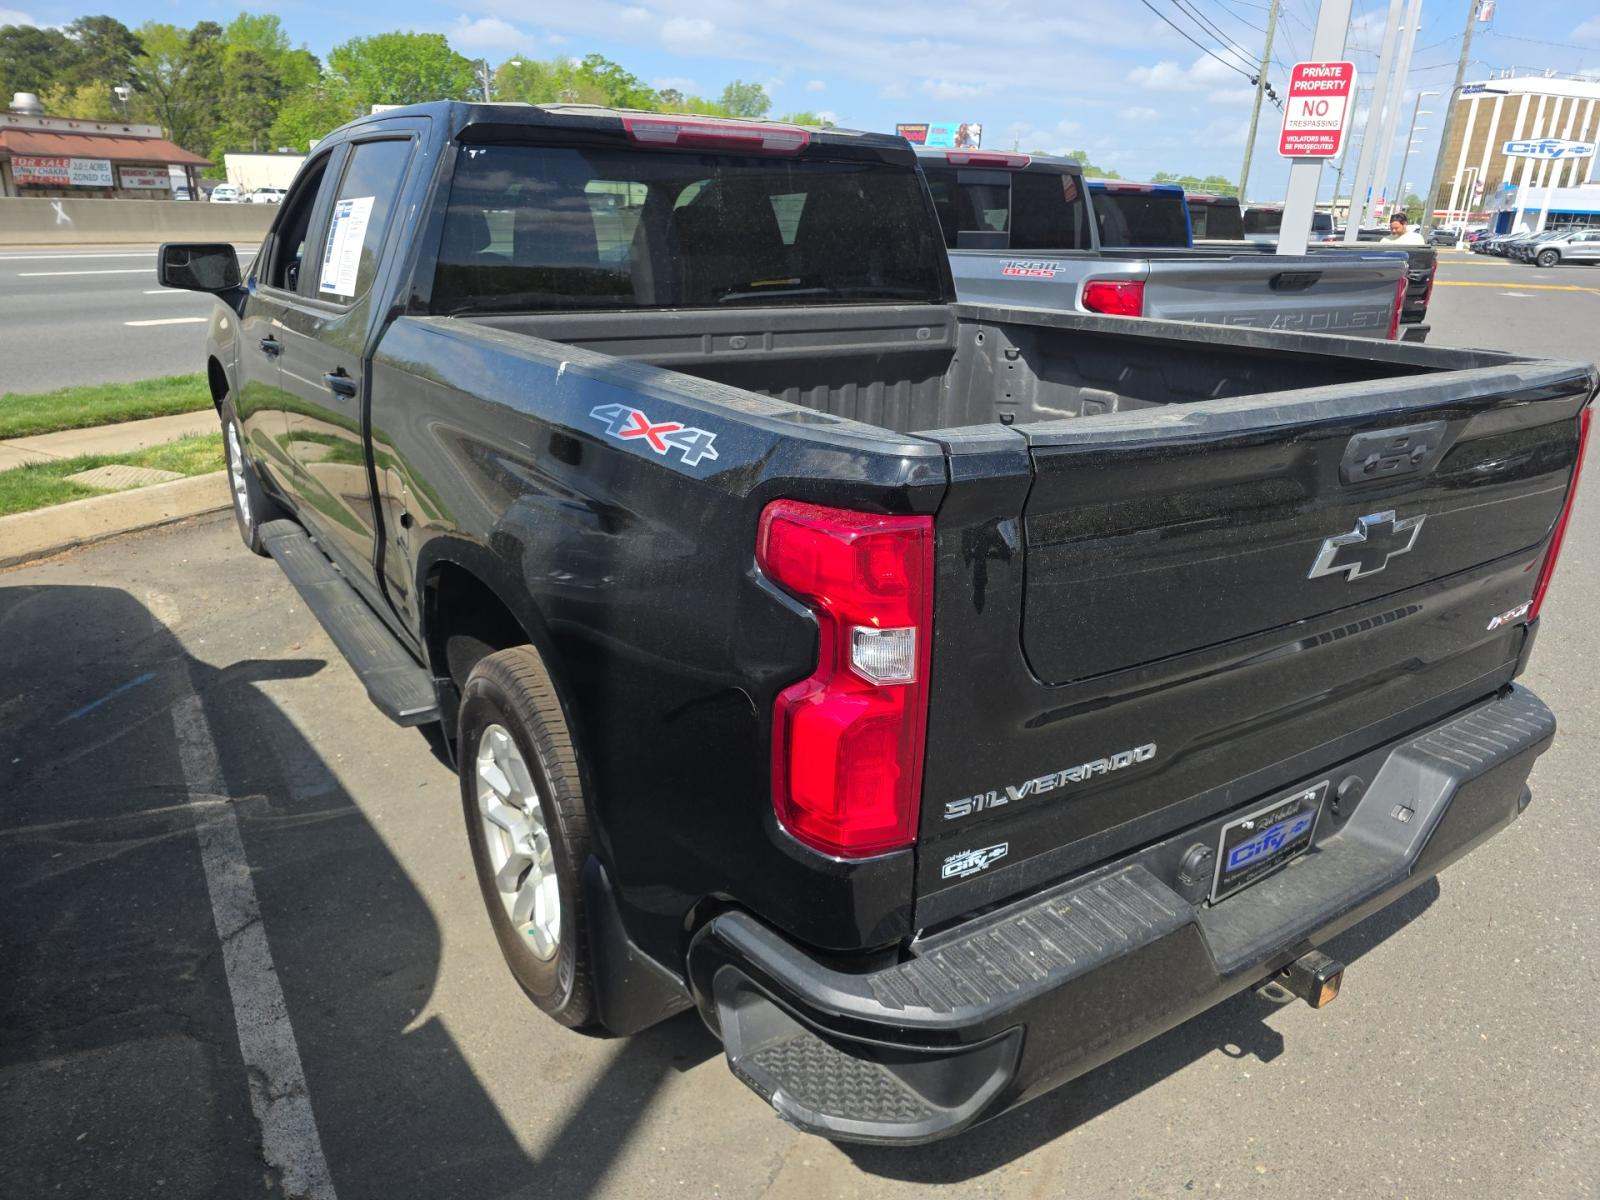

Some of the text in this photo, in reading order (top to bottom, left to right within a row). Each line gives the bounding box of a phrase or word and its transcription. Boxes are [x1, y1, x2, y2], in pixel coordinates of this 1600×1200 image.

[1303, 67, 1342, 77] PRIVATE
[1294, 80, 1346, 90] PROPERTY
[1302, 100, 1329, 117] NO
[1289, 120, 1338, 128] TRESPASSING
[11, 157, 70, 168] FOR SALE
[1002, 268, 1055, 278] BOSS
[943, 741, 1158, 820] SILVERADO
